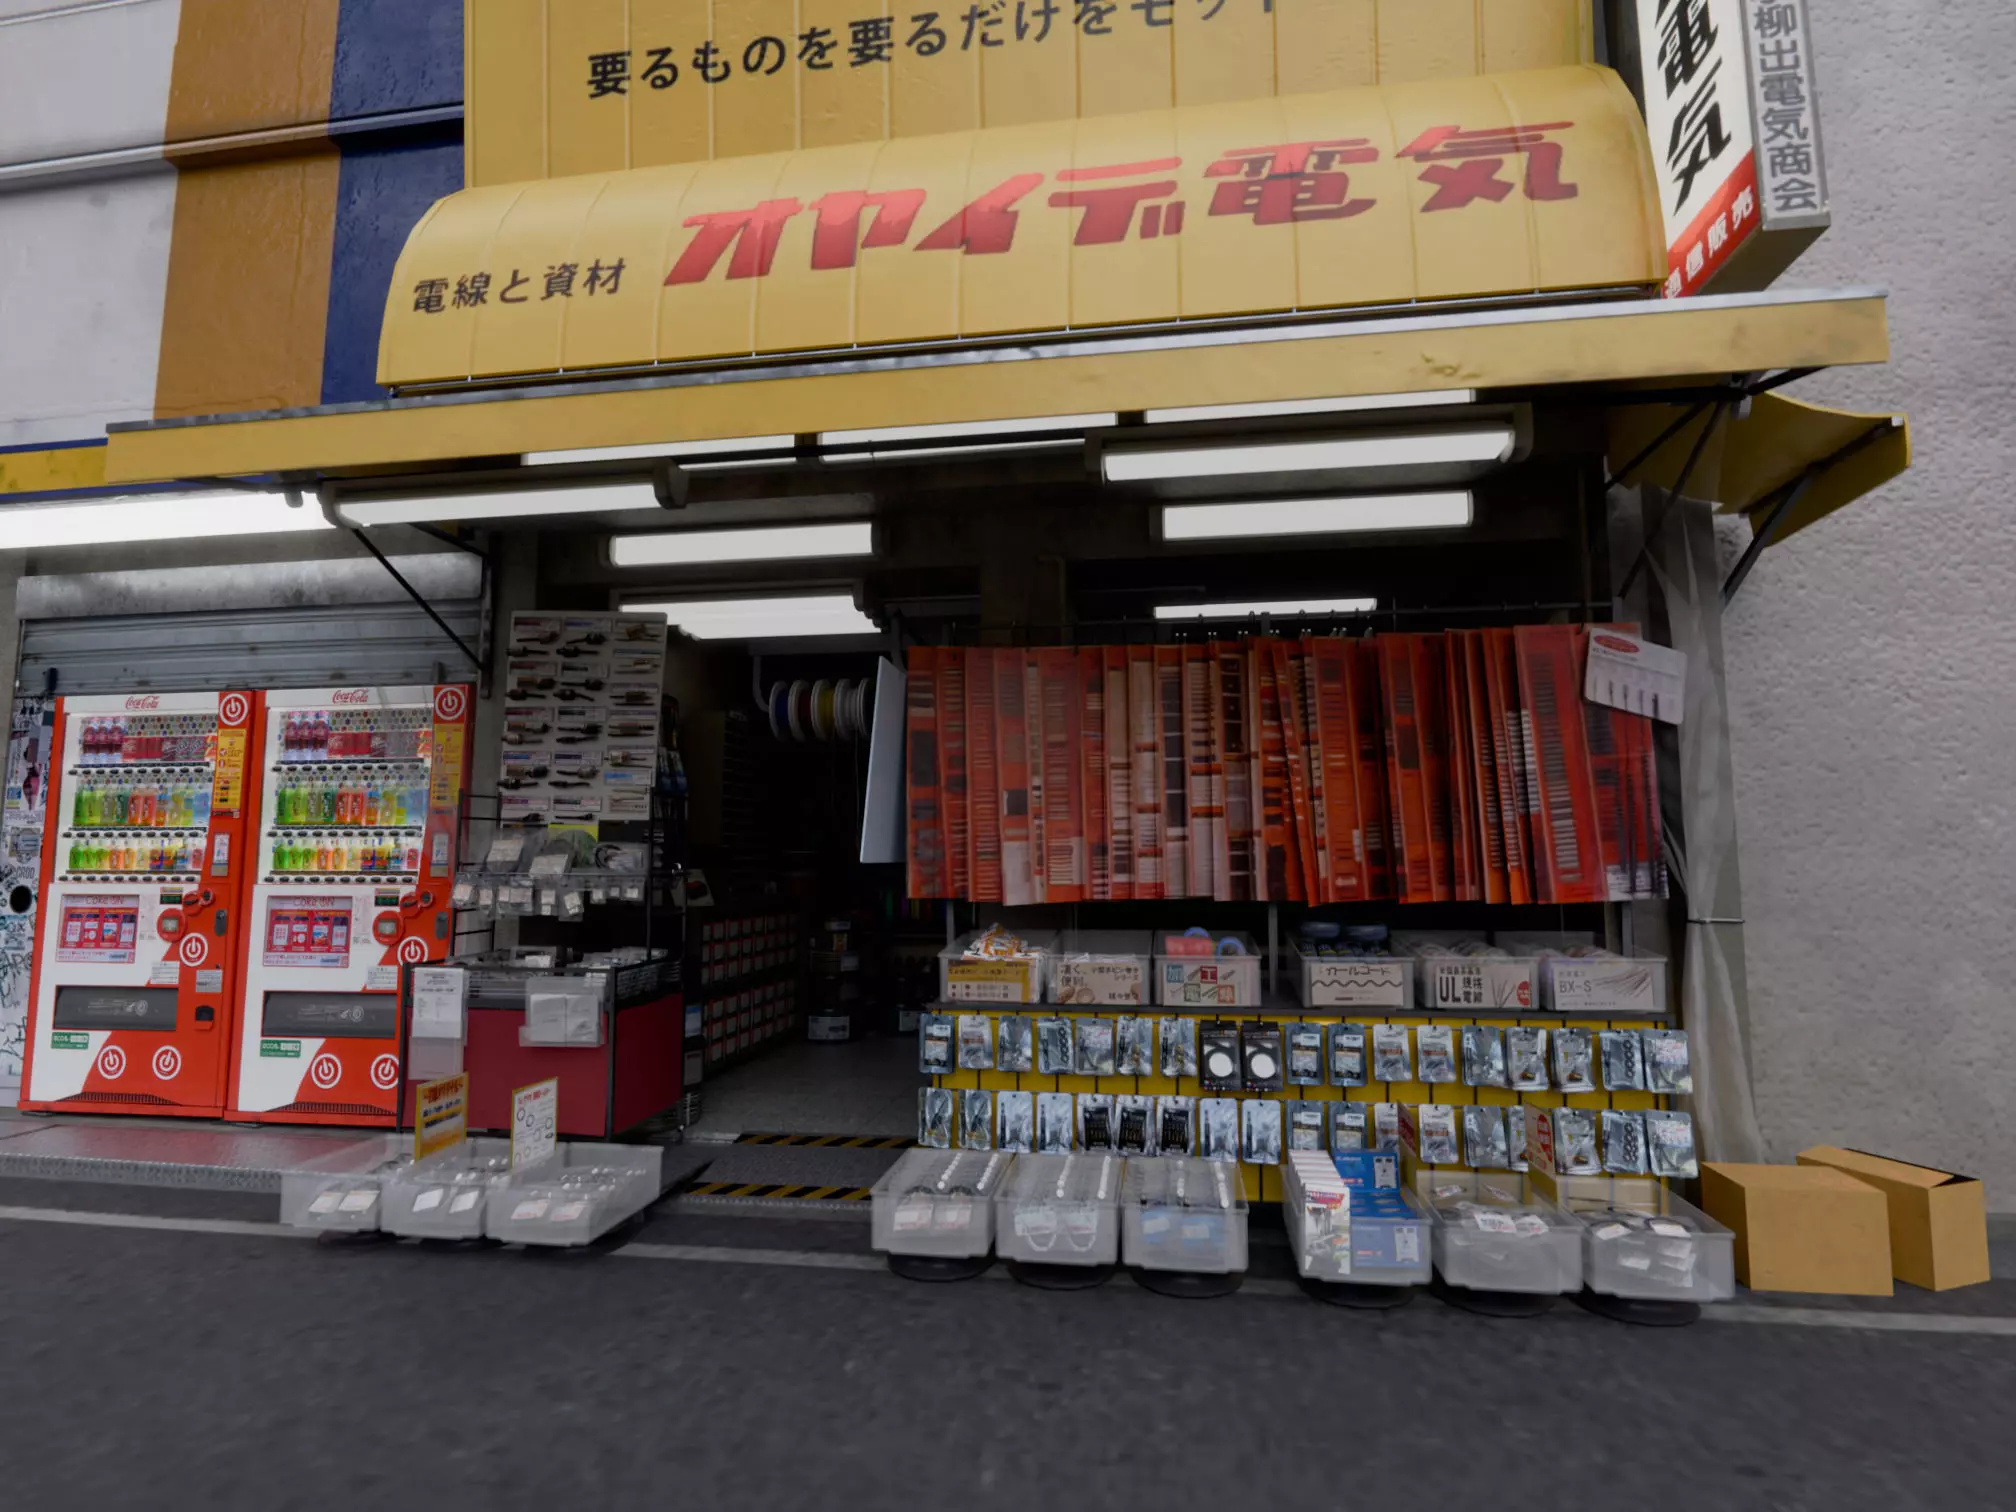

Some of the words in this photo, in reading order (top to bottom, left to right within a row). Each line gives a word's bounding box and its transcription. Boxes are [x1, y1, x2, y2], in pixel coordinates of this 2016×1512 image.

[586, 0, 1273, 98] 要るものを要るだけをモ
[1754, 0, 1818, 212] 柳出電気商会
[664, 121, 1579, 285] オヤイデ電気
[413, 257, 626, 314] 電線と資材
[1439, 976, 1461, 1003] UL
[1559, 979, 1592, 993] BX-S
